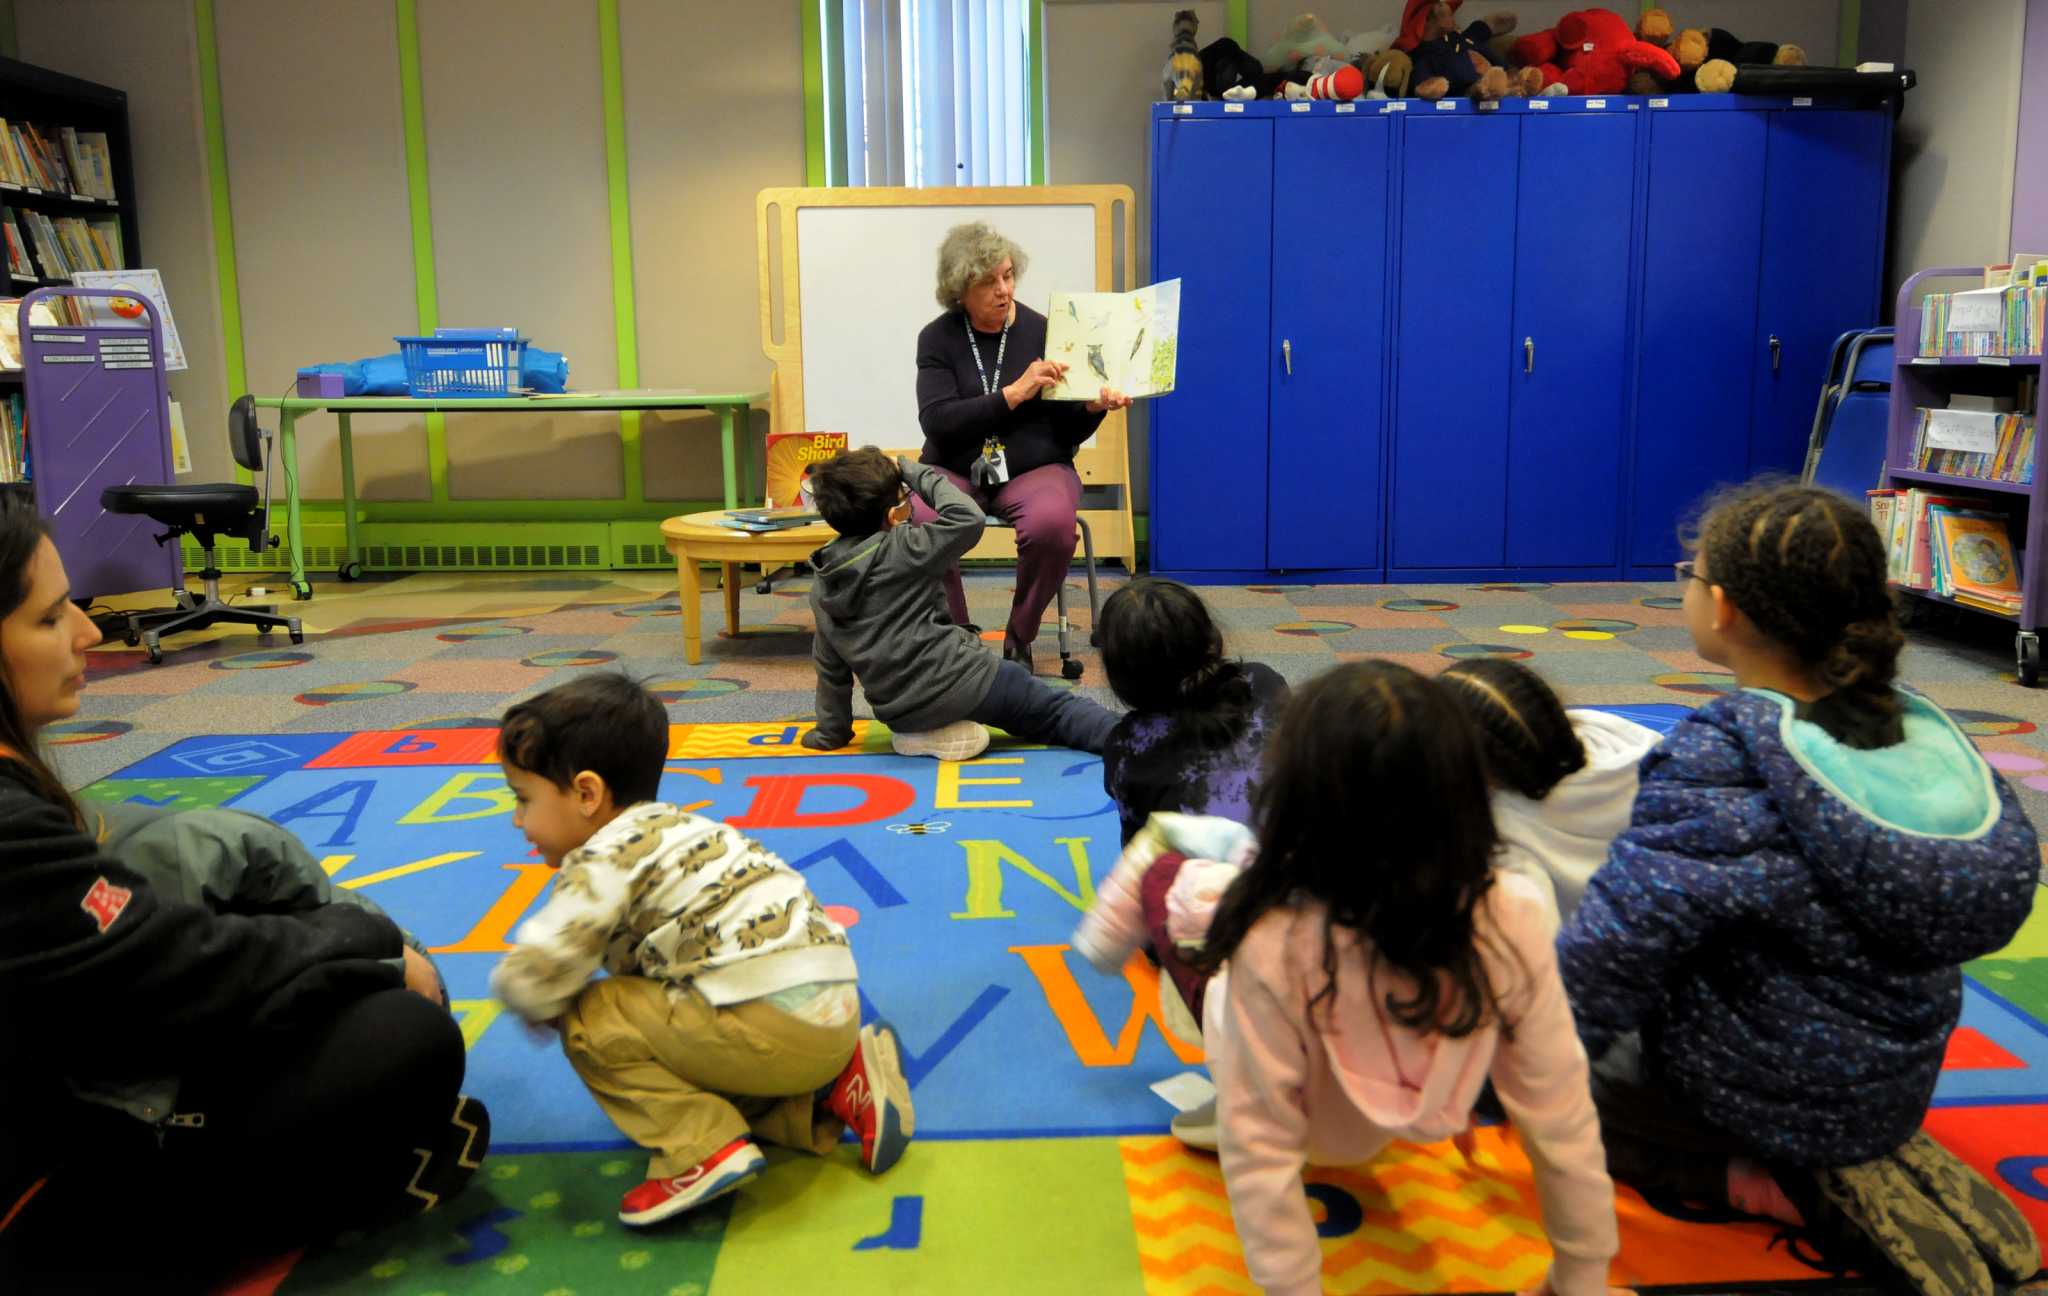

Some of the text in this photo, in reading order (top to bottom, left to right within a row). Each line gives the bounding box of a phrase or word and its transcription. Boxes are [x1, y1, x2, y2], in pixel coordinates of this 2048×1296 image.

[814, 434, 847, 449] Bird
[724, 773, 917, 829] D
[935, 757, 1033, 809] E
